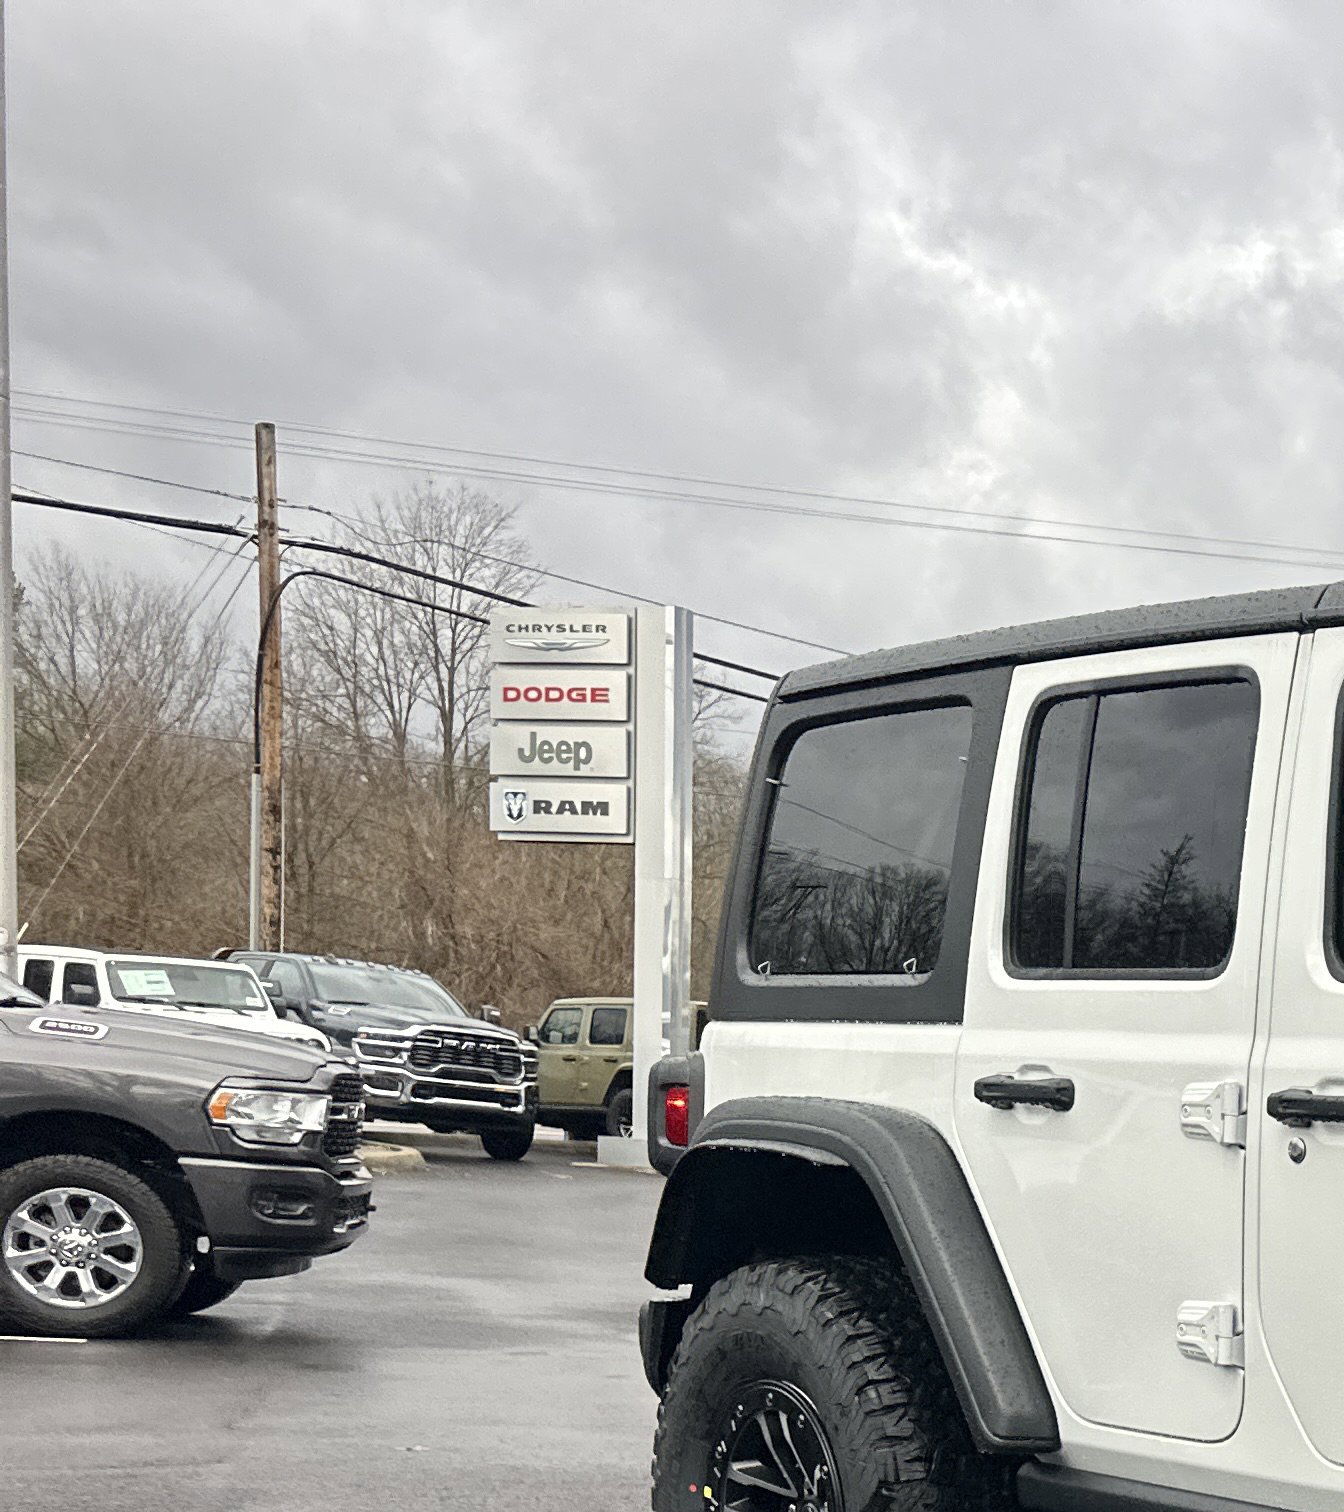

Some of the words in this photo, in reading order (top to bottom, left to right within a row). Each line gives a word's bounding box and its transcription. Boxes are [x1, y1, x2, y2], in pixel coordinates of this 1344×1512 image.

[505, 623, 607, 634] CHRYSLER
[502, 686, 610, 703] DODGE
[517, 731, 593, 771] Jeep
[532, 799, 609, 816] RAM
